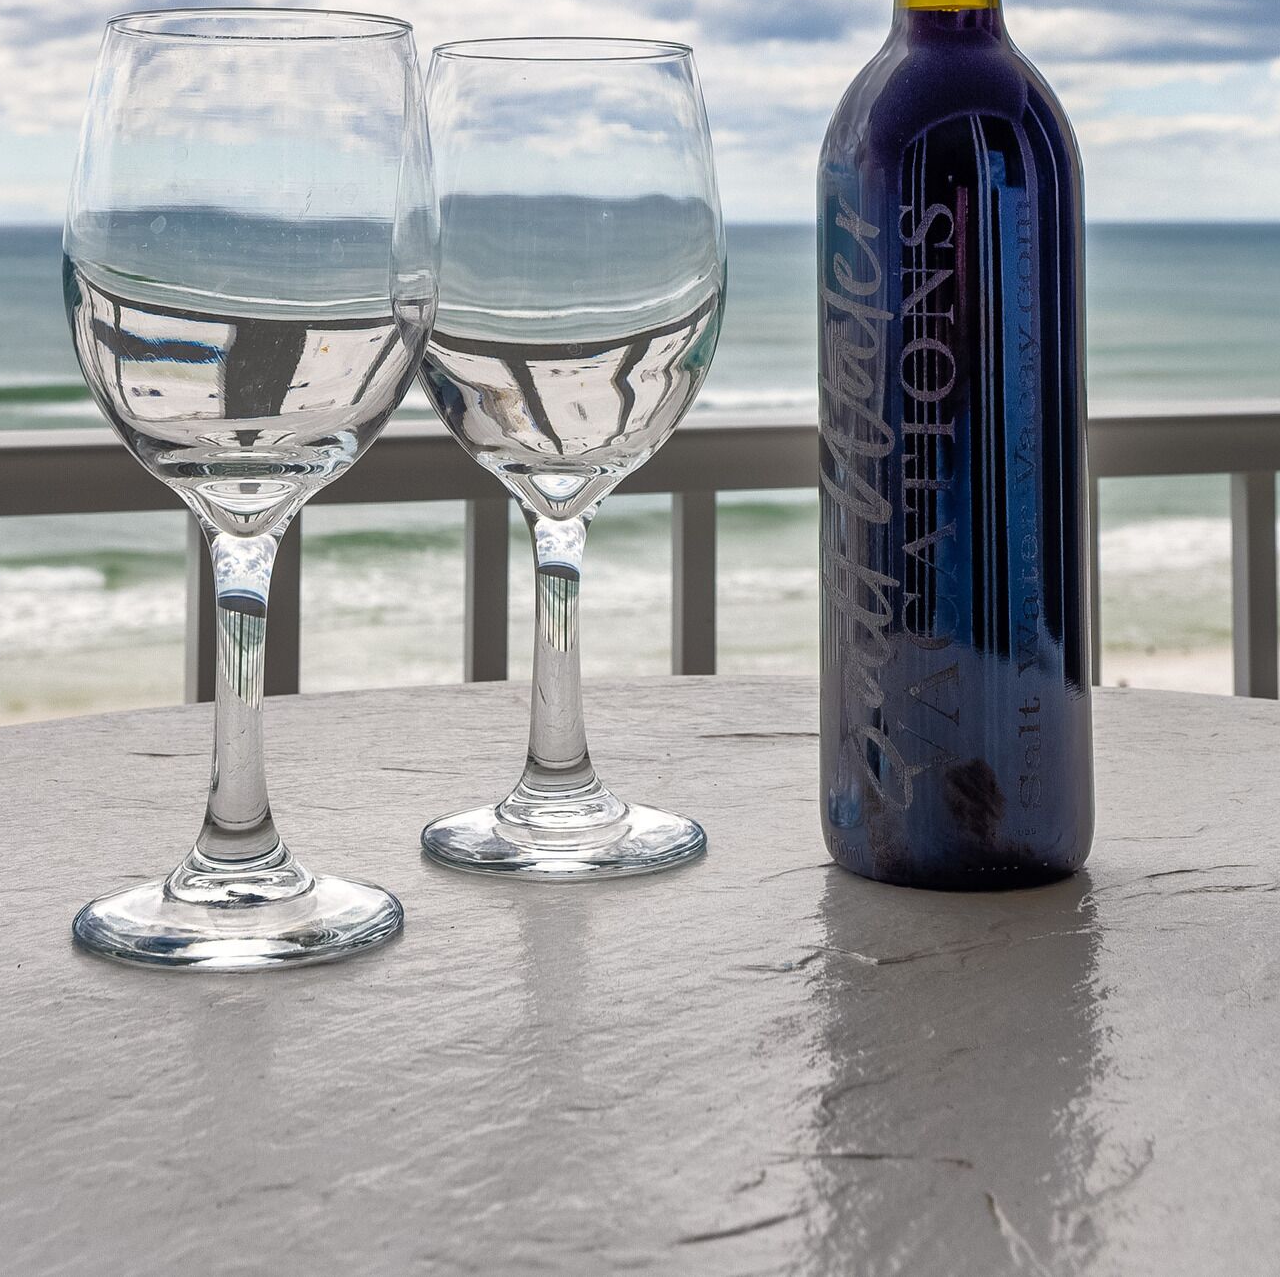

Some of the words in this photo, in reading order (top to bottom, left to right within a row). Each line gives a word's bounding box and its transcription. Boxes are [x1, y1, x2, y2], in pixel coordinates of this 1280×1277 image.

[820, 195, 895, 525] Water
[897, 203, 959, 775] VACATIONS
[821, 538, 913, 811] Salt
[1016, 508, 1041, 677] Water
[1017, 696, 1042, 810] Salt
